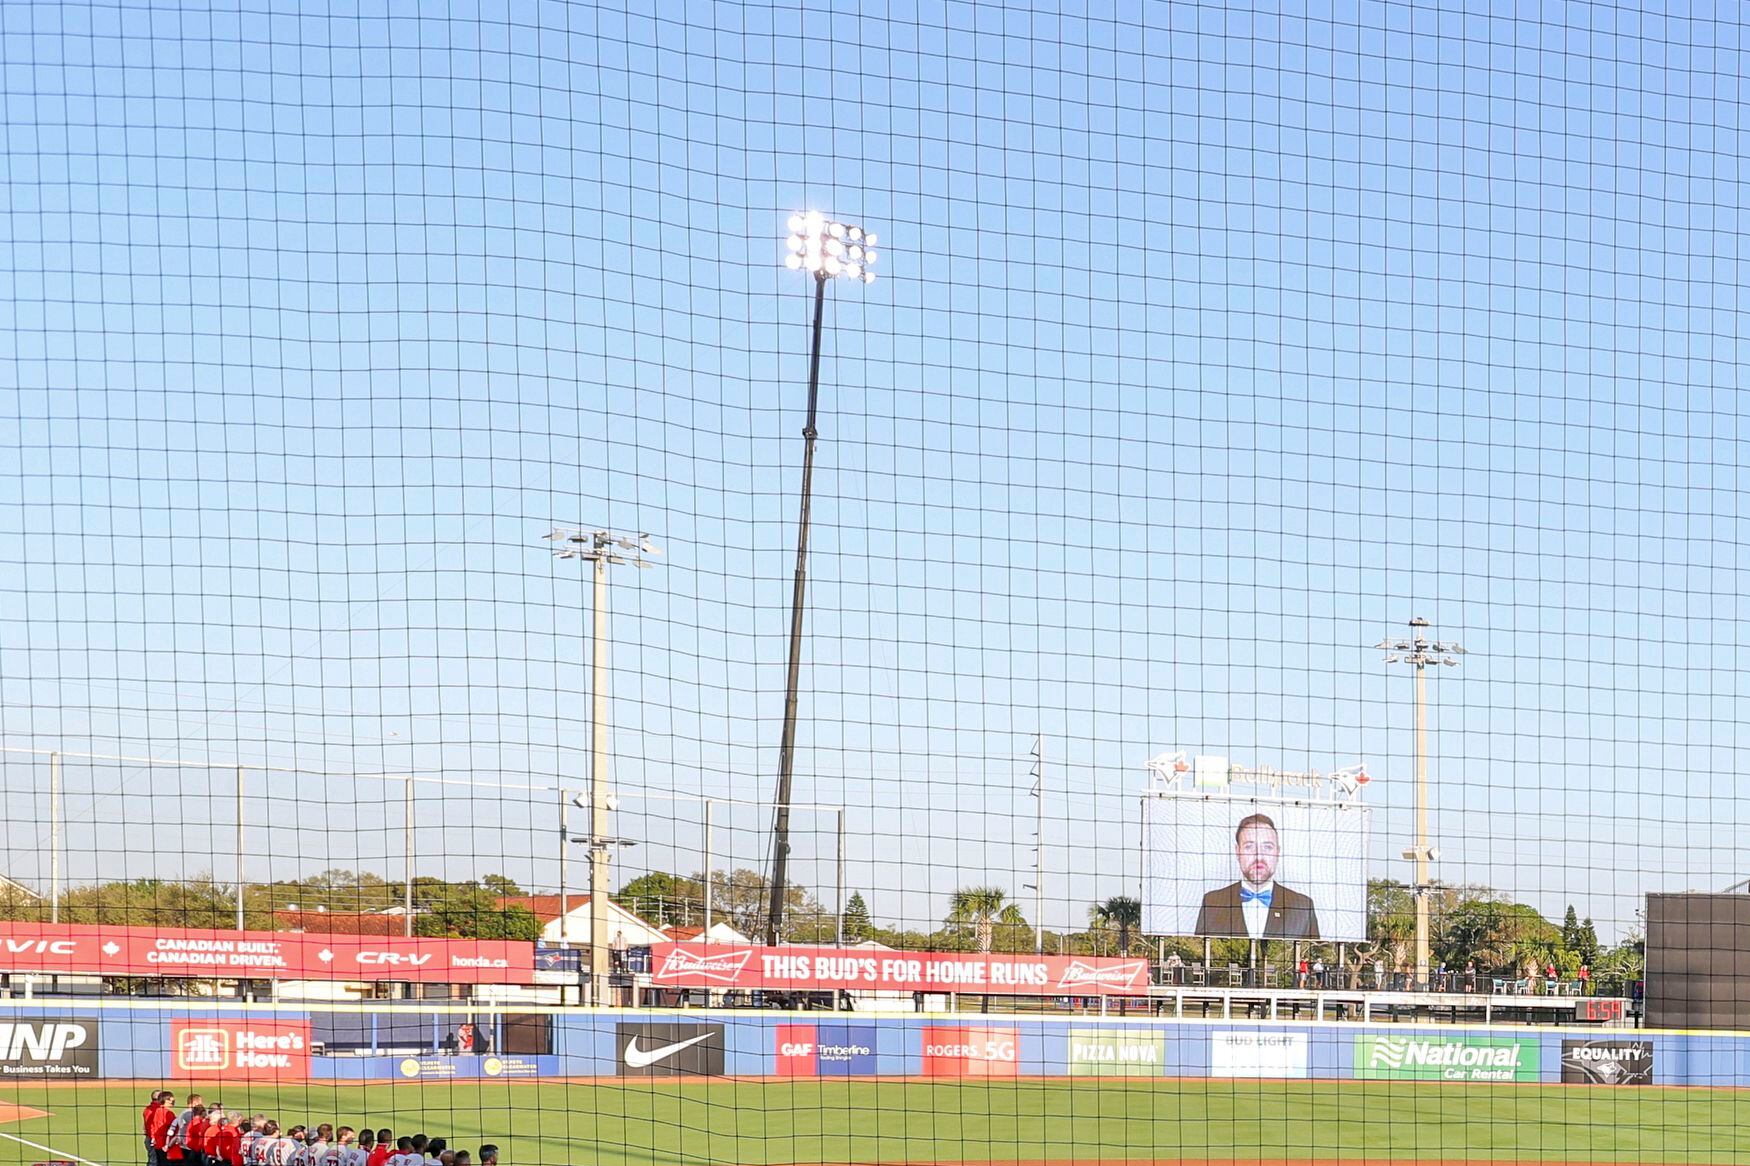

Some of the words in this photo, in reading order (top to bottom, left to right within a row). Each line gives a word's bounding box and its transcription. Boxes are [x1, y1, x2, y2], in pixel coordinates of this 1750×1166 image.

[156, 939, 235, 953] CANADIAN
[147, 952, 227, 965] CANADIAN
[230, 954, 287, 967] DRIVEN.
[356, 951, 431, 965] CR-V
[452, 955, 508, 968] honda.ca
[665, 953, 742, 971] Budweiser
[762, 955, 803, 979] THIS
[815, 956, 877, 981] BUD'S
[882, 959, 920, 982] FOR
[926, 961, 985, 984] HOME
[991, 962, 1048, 985] RUNS
[1065, 965, 1135, 983] Budweiser
[237, 1032, 304, 1050] Here's
[1226, 1036, 1253, 1046] BUD
[1256, 1036, 1294, 1047] LIGHT
[781, 1043, 812, 1057] GAF
[817, 1044, 870, 1056] Timberline
[927, 1045, 978, 1057] ROGERS
[984, 1041, 1014, 1061] 5G
[1073, 1043, 1115, 1063] PIZZA
[1118, 1045, 1158, 1063] NOVA
[1572, 1047, 1642, 1061] EQUALITY
[237, 1051, 291, 1068] How.
[3, 1065, 43, 1074] Business
[45, 1065, 71, 1074] Takes
[72, 1065, 90, 1074] You
[1444, 1068, 1464, 1079] Car
[1471, 1068, 1514, 1081] Rental
